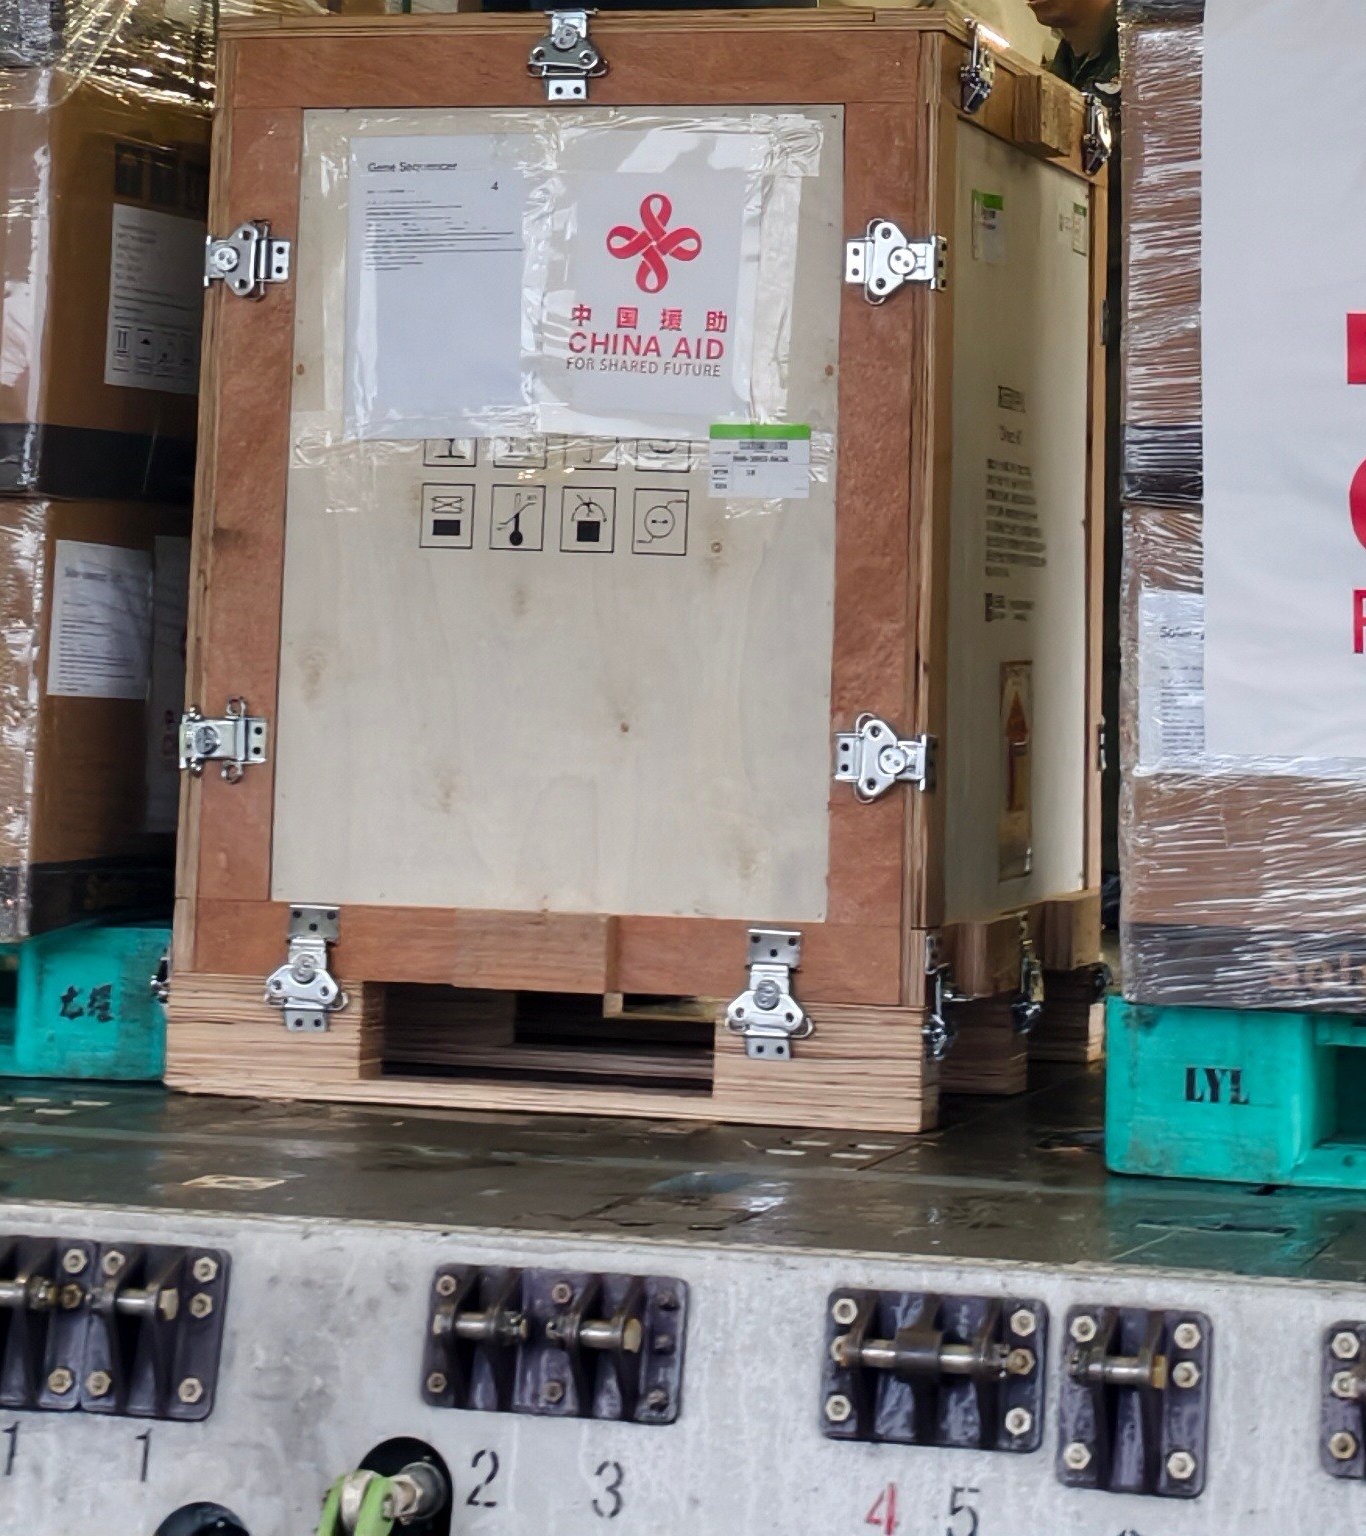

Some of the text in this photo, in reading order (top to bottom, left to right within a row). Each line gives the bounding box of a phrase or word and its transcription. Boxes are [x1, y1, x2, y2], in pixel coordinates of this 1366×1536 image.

[571, 304, 728, 334] 中国援助
[566, 357, 722, 378] FOR SHARED FUTURE
[568, 332, 725, 360] CHINA AID
[1184, 1066, 1250, 1106] LYL
[1, 1420, 20, 1477] 1
[135, 1428, 152, 1484] 1
[465, 1449, 500, 1509] 2
[591, 1460, 624, 1519] 3
[864, 1482, 900, 1536] 4
[946, 1486, 981, 1536] 5
